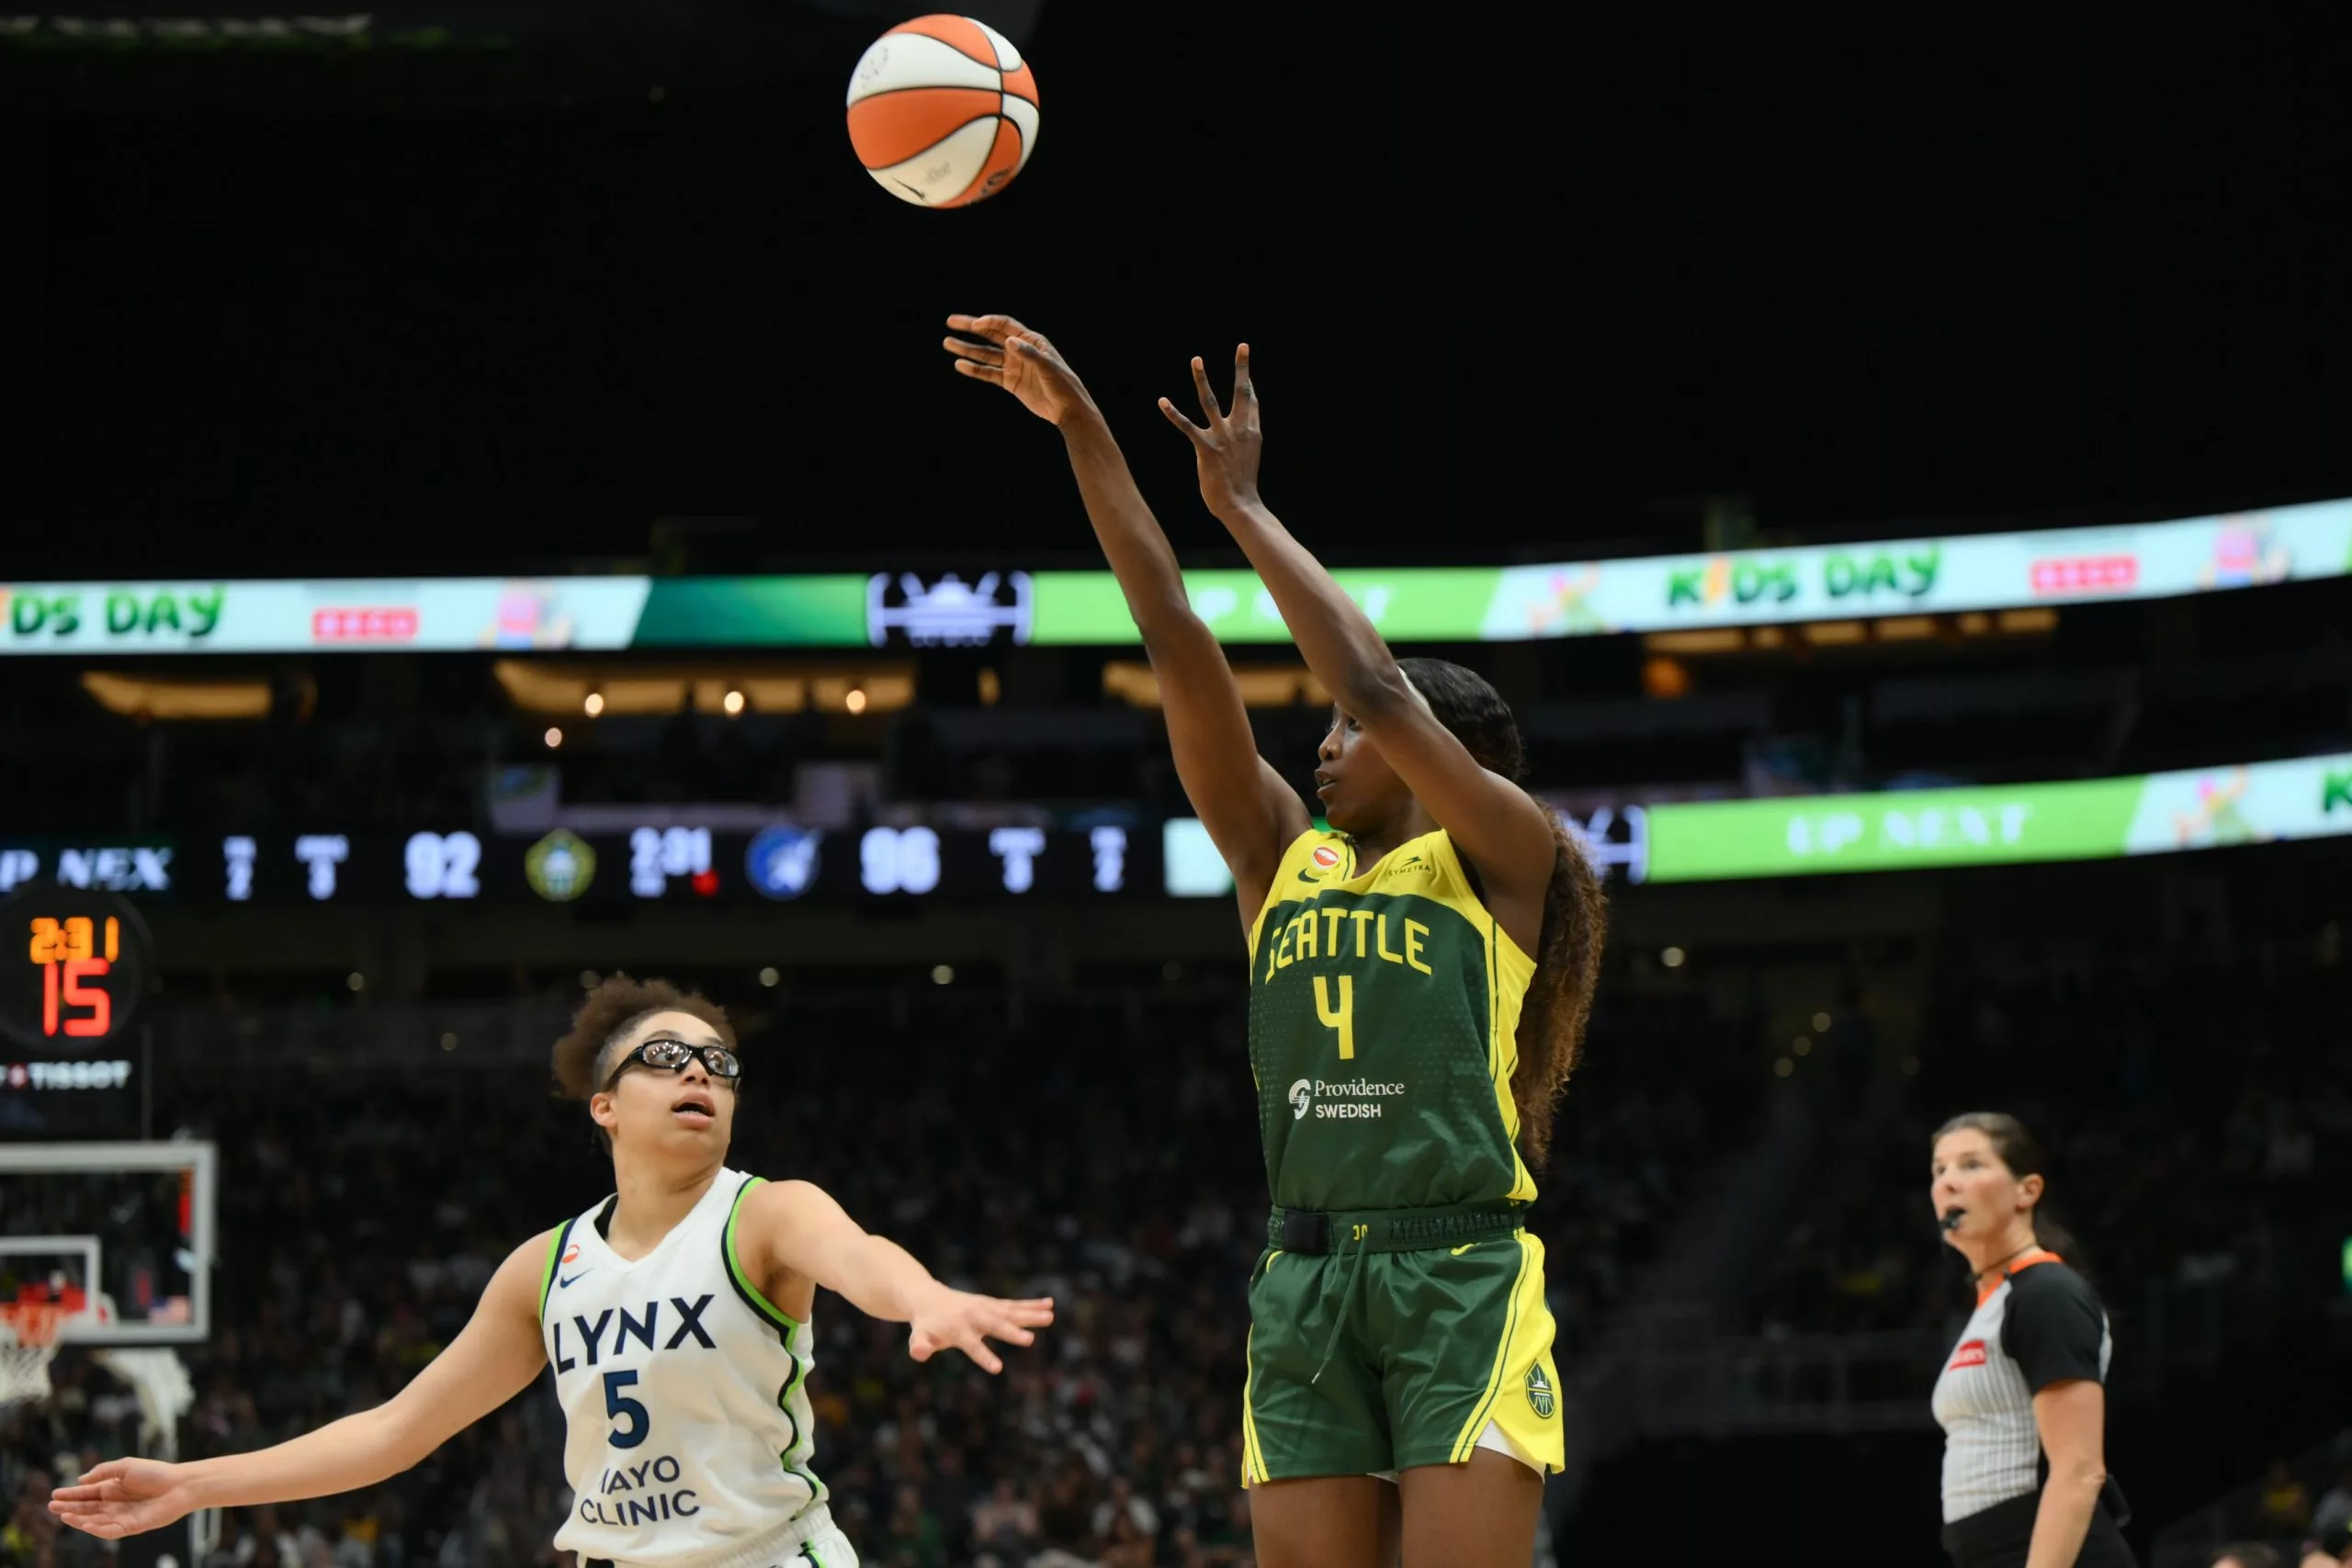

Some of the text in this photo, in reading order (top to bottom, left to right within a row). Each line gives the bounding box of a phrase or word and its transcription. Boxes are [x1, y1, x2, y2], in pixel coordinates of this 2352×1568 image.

[1826, 542, 1942, 599] DAY
[105, 588, 228, 637] DAY
[1786, 802, 2033, 856] UP NEXT
[1388, 864, 1430, 875] SYMETRA
[1265, 908, 1431, 985] SEATTLE
[43, 957, 110, 1036] 15
[1313, 975, 1354, 1059] 4
[28, 1060, 132, 1090] TISSOT
[1314, 1078, 1405, 1097] Providence
[1315, 1103, 1382, 1119] SWEDISH
[553, 1294, 717, 1375] LYNX
[603, 1370, 650, 1450] 5
[580, 1489, 700, 1527] CLINIC
